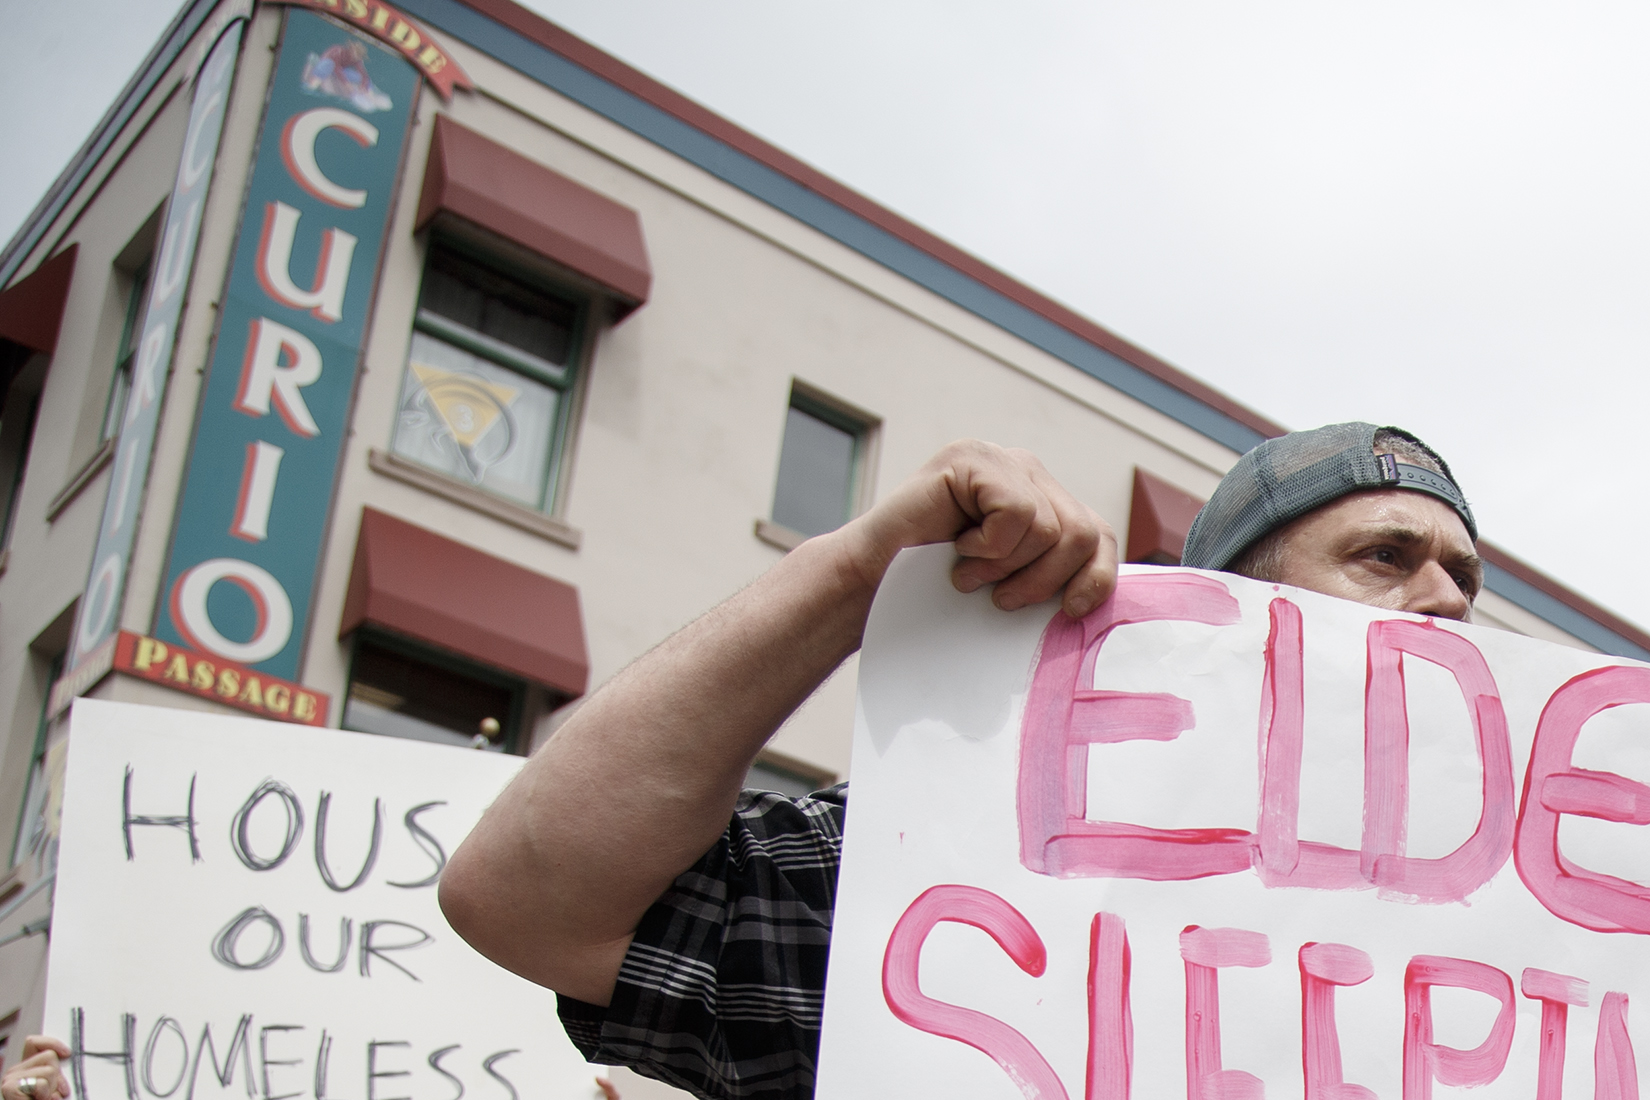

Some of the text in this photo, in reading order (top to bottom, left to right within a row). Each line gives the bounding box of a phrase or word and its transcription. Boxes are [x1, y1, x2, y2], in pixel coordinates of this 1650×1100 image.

[316, 0, 447, 74] SIDE
[171, 107, 380, 662] CURIO
[133, 635, 318, 723] PASSAGE
[122, 762, 449, 892] HOUS
[211, 904, 435, 983] OUR
